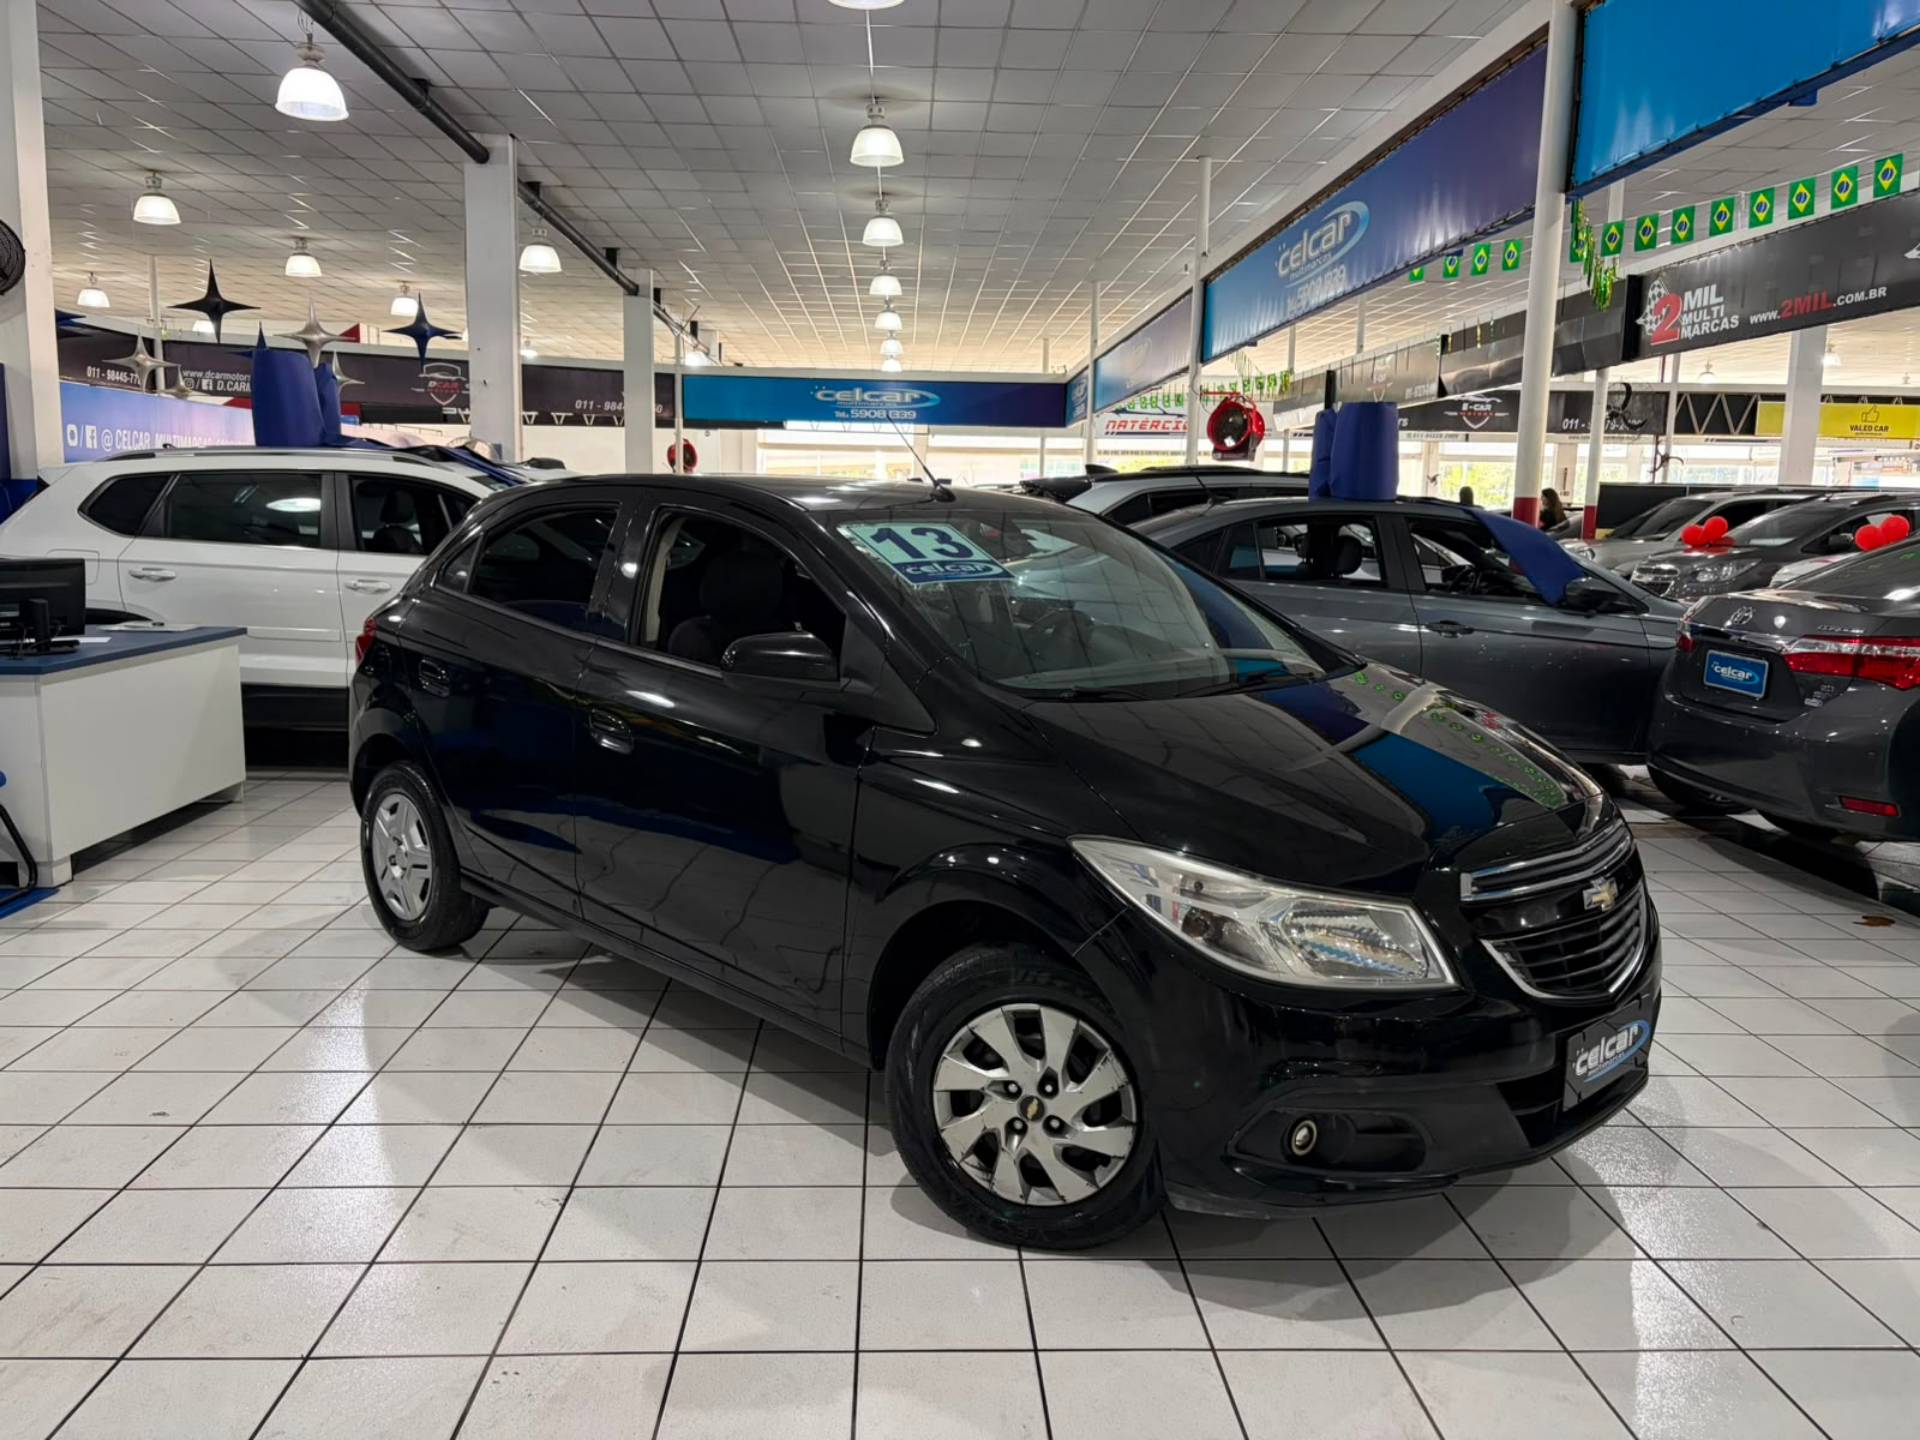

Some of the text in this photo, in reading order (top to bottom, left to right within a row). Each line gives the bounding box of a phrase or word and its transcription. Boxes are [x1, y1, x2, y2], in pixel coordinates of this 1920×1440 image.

[1278, 211, 1352, 277] celcar
[1650, 284, 1724, 346] 2 MIL
[1681, 304, 1725, 325] MULTI
[1681, 315, 1739, 340] MARCAS
[816, 387, 921, 402] celcar
[116, 430, 150, 450] CELCAR
[870, 527, 974, 559] 13
[905, 563, 984, 576] celcar
[1714, 666, 1753, 680] celcar
[1575, 1023, 1639, 1076] celcar
